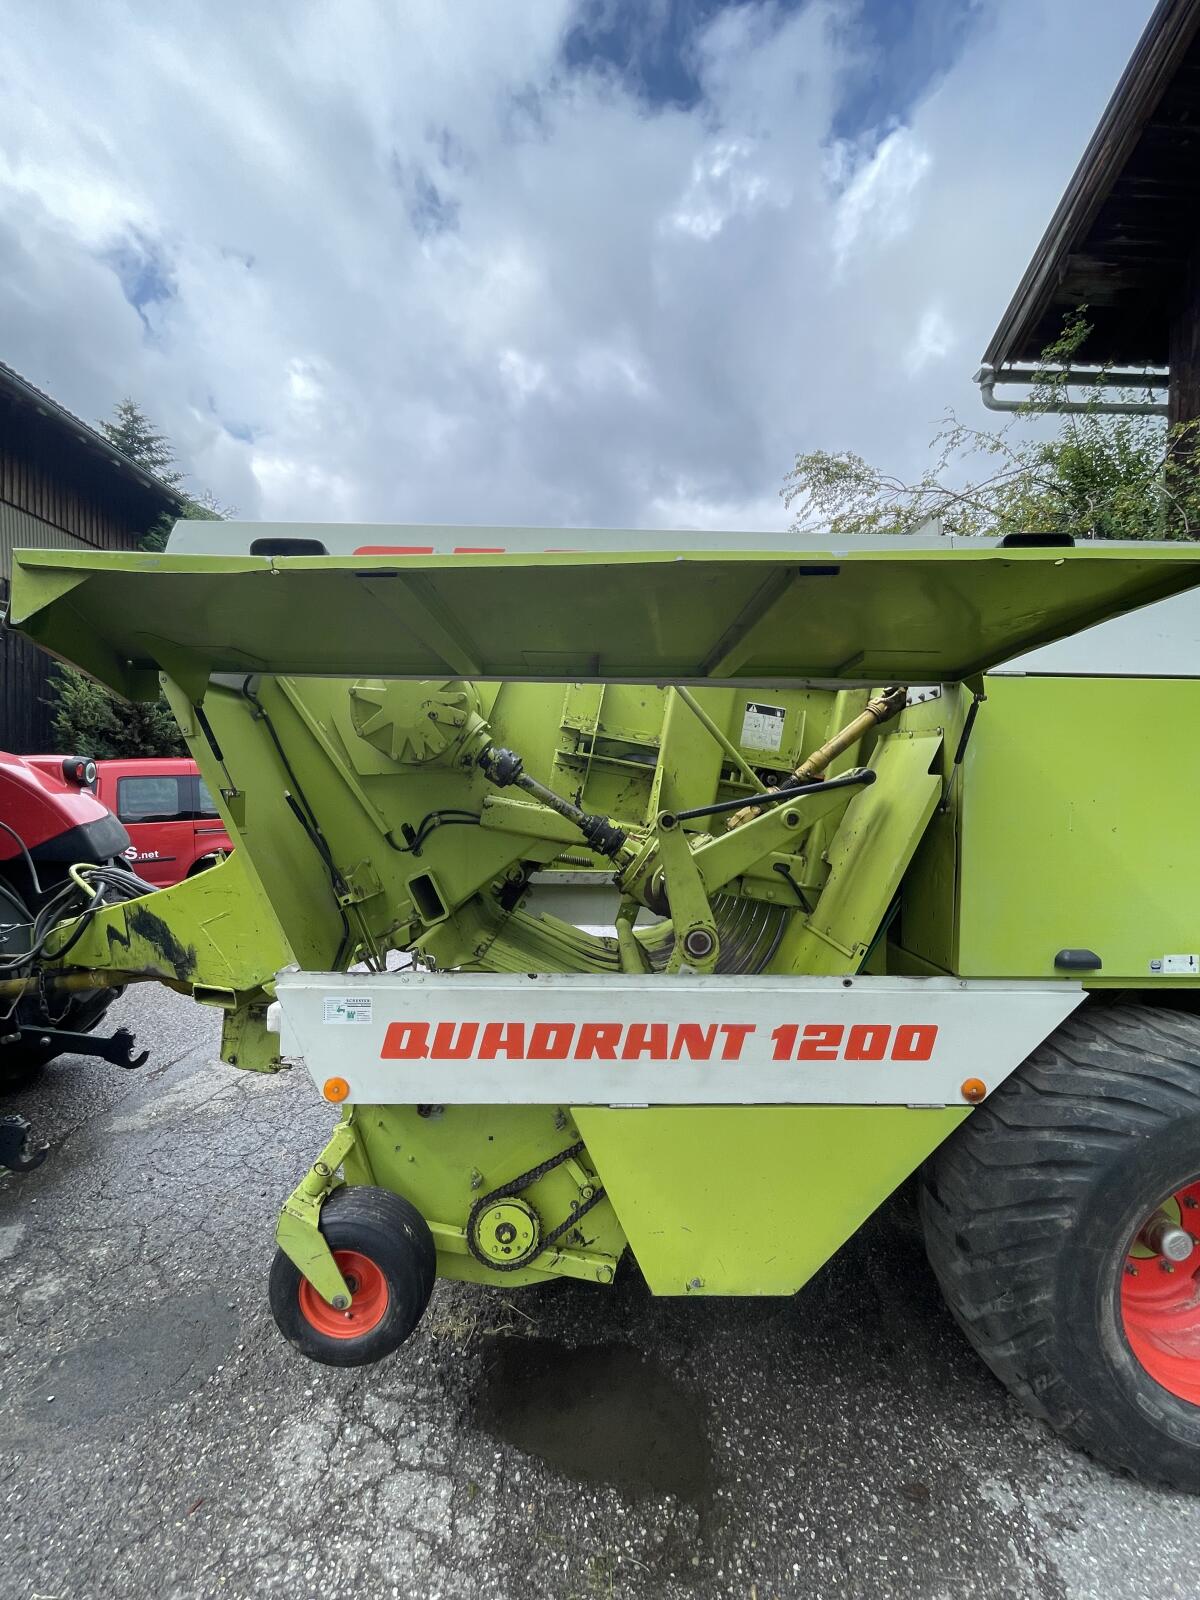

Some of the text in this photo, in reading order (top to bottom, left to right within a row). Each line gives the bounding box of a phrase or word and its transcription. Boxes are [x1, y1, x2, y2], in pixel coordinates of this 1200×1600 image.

[122, 846, 159, 860] S.net
[380, 1022, 939, 1061] QUADRANT 1200
